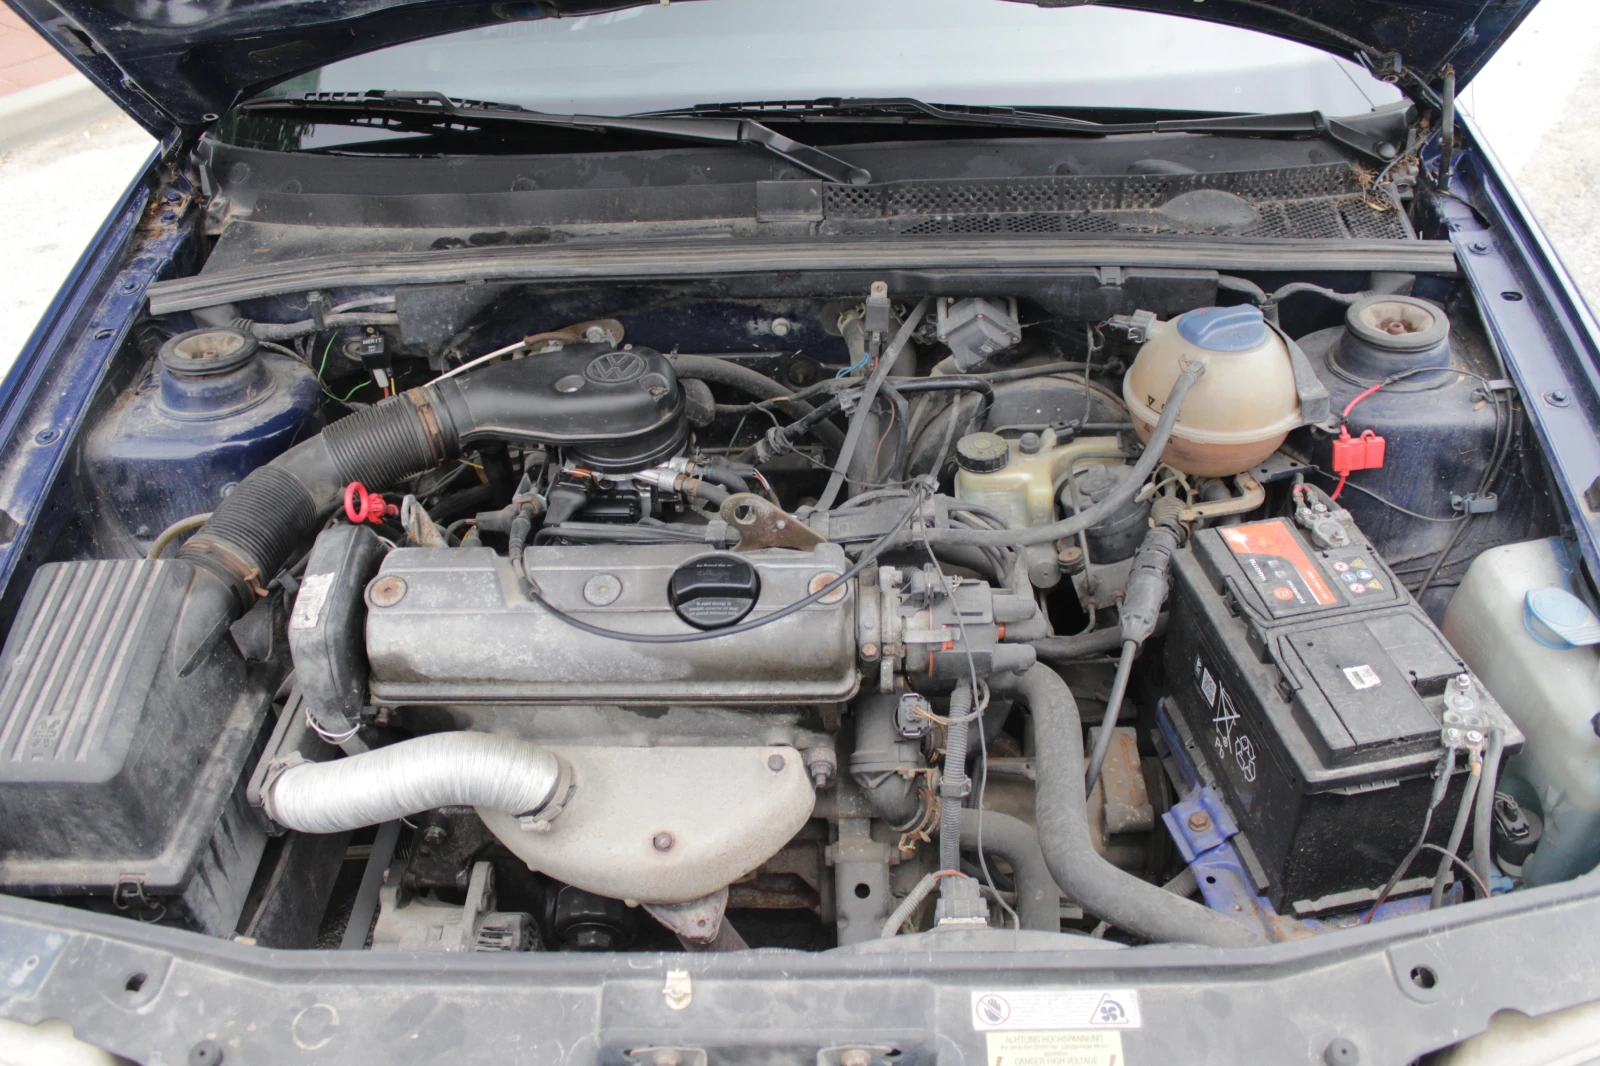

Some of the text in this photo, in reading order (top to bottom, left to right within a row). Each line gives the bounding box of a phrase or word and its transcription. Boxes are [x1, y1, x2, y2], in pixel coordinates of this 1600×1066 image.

[362, 337, 382, 345] MERIT
[1005, 1034, 1103, 1044] ACHTUNG HOCHSPANNUNG
[1015, 1056, 1098, 1066] DANGER HIGH VOLTAGE
